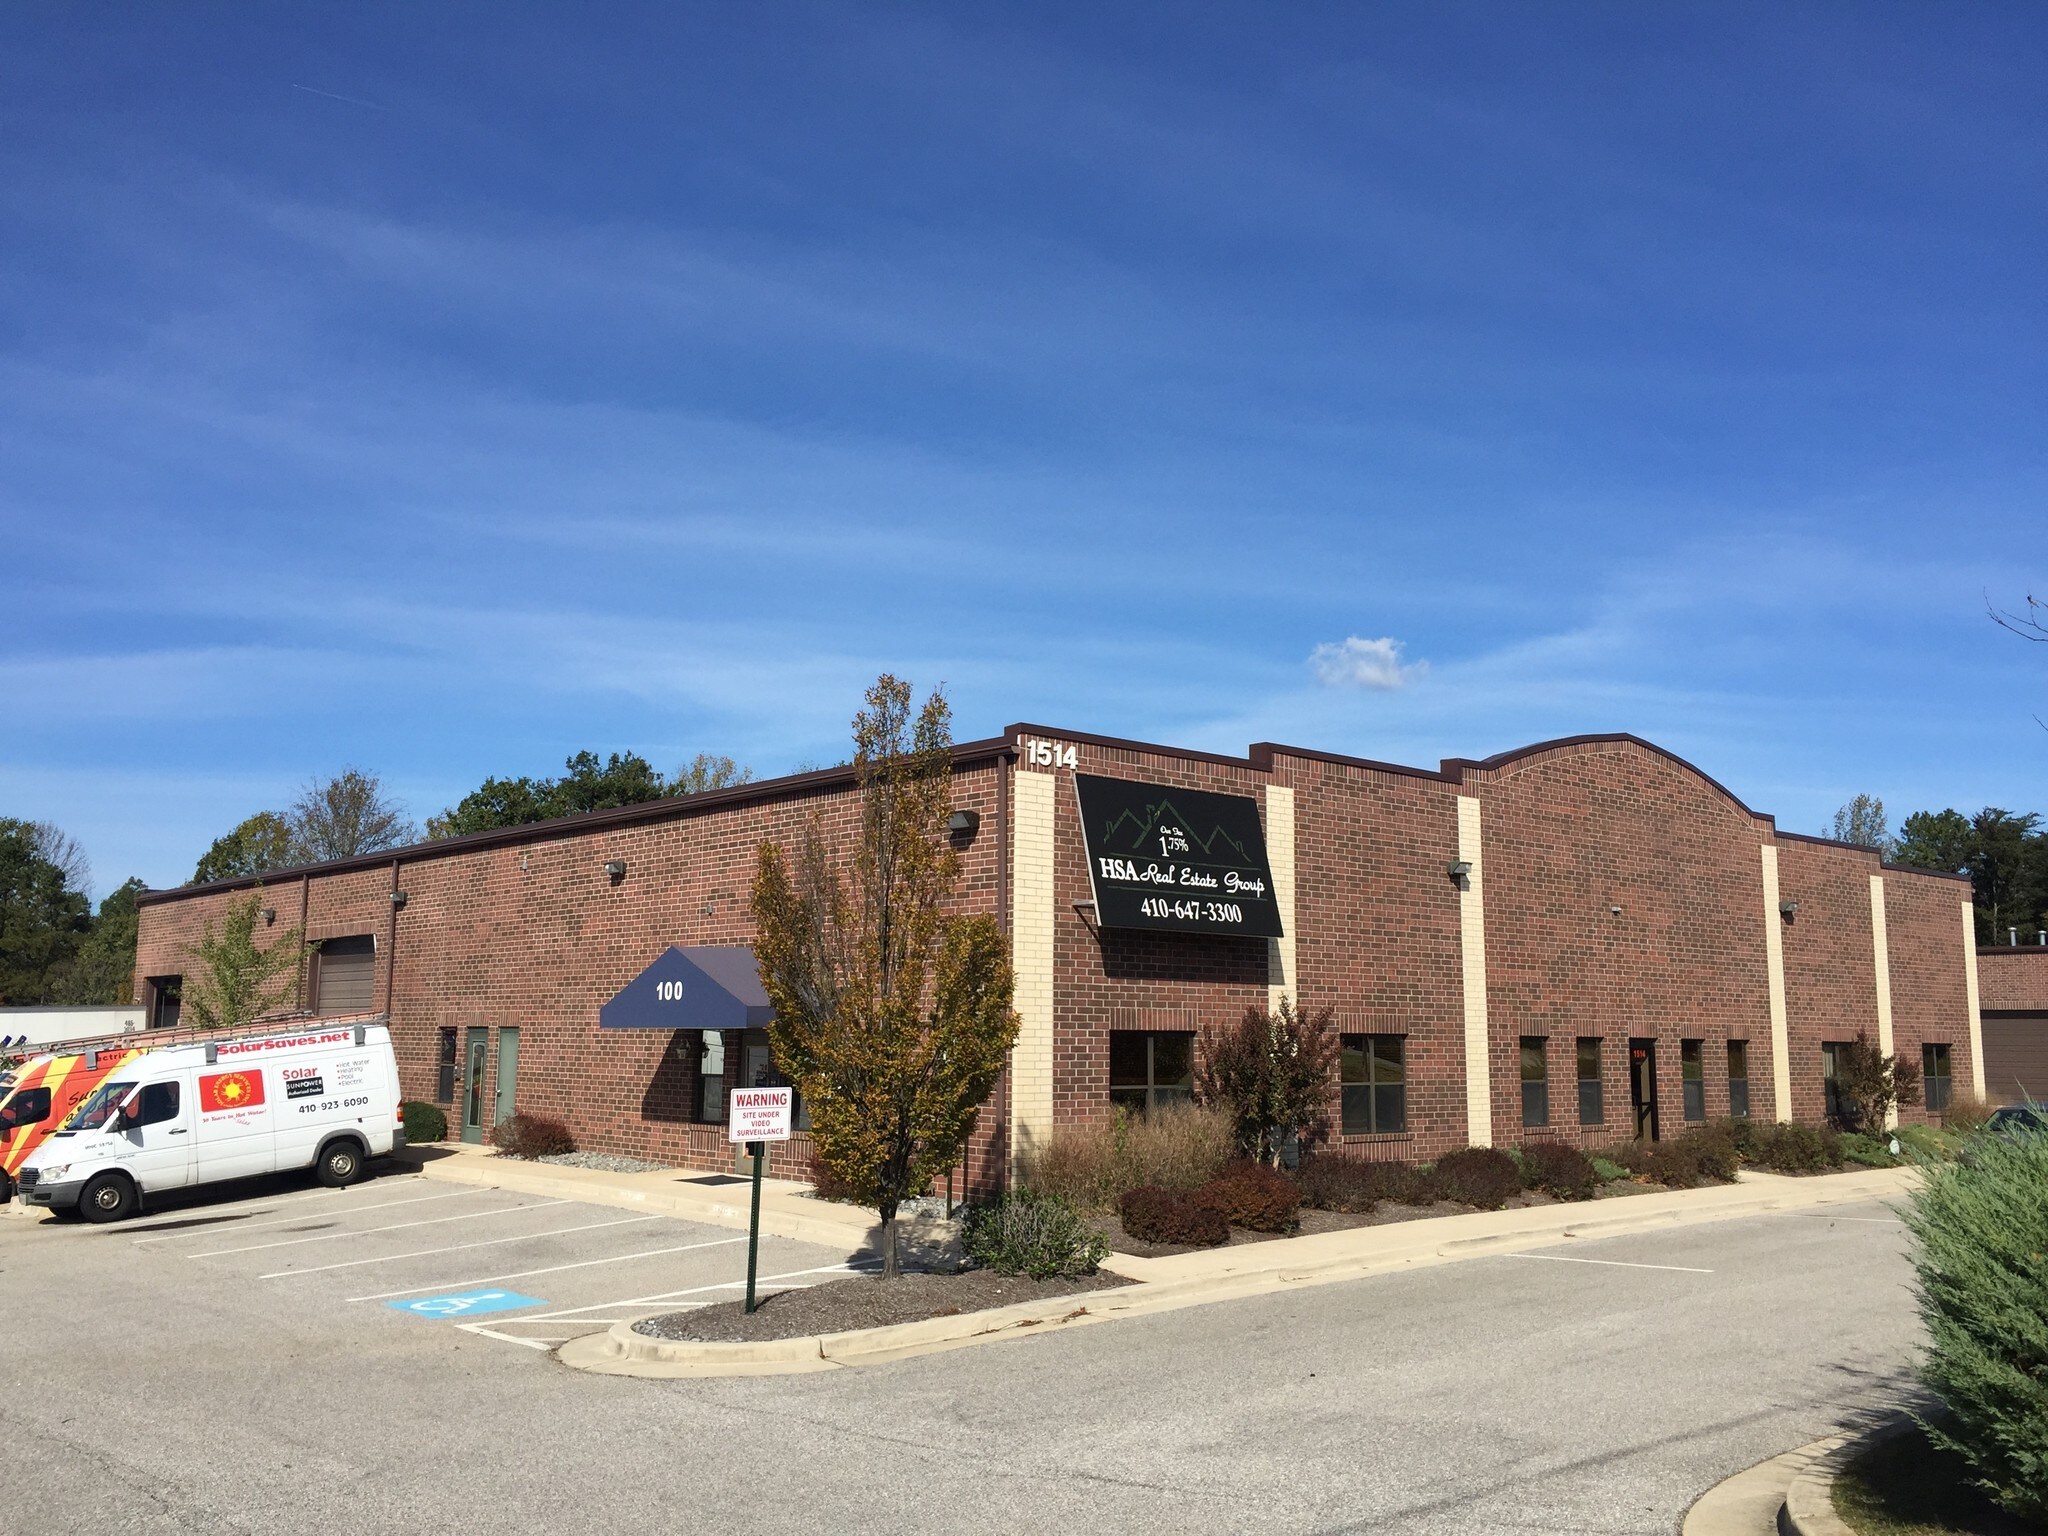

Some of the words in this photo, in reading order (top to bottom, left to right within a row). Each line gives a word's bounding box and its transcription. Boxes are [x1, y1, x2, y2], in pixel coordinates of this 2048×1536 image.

[1027, 739, 1078, 769] 1514
[1159, 836, 1189, 857] 1.75%
[1099, 858, 1140, 881] HSA
[1140, 864, 1176, 885] Real
[1180, 868, 1218, 888] Estate
[1224, 871, 1265, 898] Group
[1141, 898, 1242, 923] 410-647-3300
[656, 981, 683, 1001] 100
[217, 1031, 350, 1055] SolarSaves.net
[282, 1066, 318, 1080] Solar
[287, 1079, 322, 1089] SUNPOWER
[299, 1096, 369, 1113] 410-923-6090
[736, 1093, 787, 1107] WARNING
[742, 1111, 756, 1119] SITE
[737, 1128, 784, 1136] SURVEILLANCE
